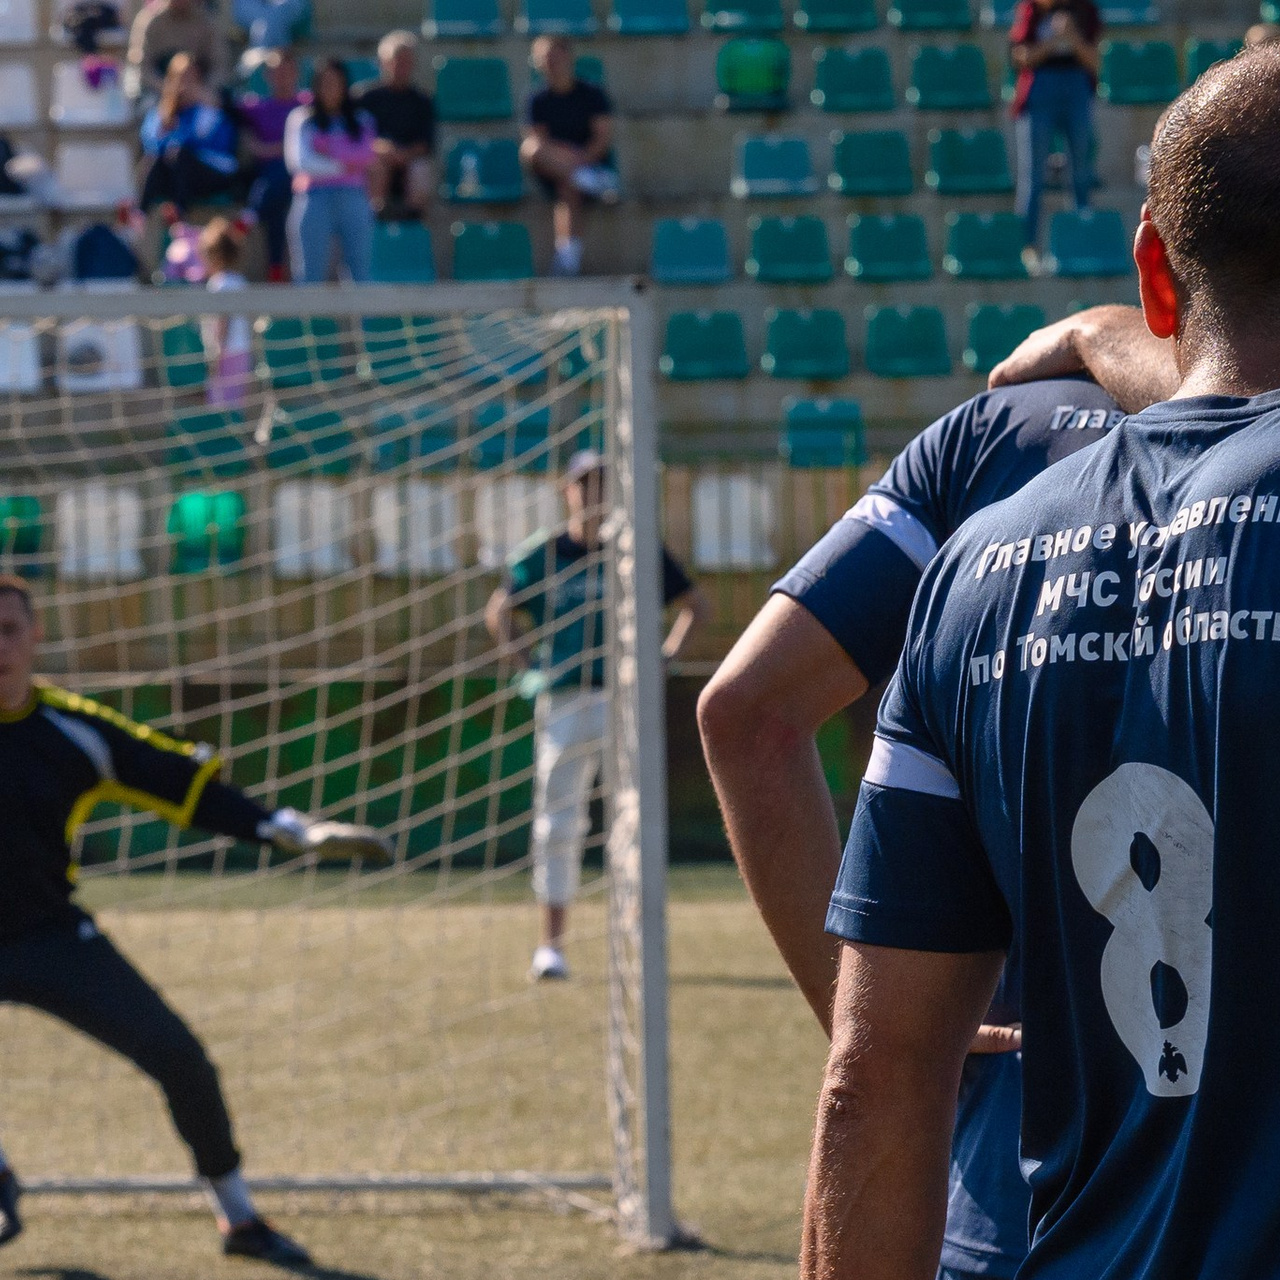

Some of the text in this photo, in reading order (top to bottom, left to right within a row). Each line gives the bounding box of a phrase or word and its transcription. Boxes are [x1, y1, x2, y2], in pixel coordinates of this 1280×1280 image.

[975, 494, 1280, 579] Главное упавлен
[1037, 556, 1228, 616] МЧС оссии
[970, 649, 1005, 686] по
[1016, 616, 1155, 672] Томскй
[1071, 762, 1215, 1097] 8
